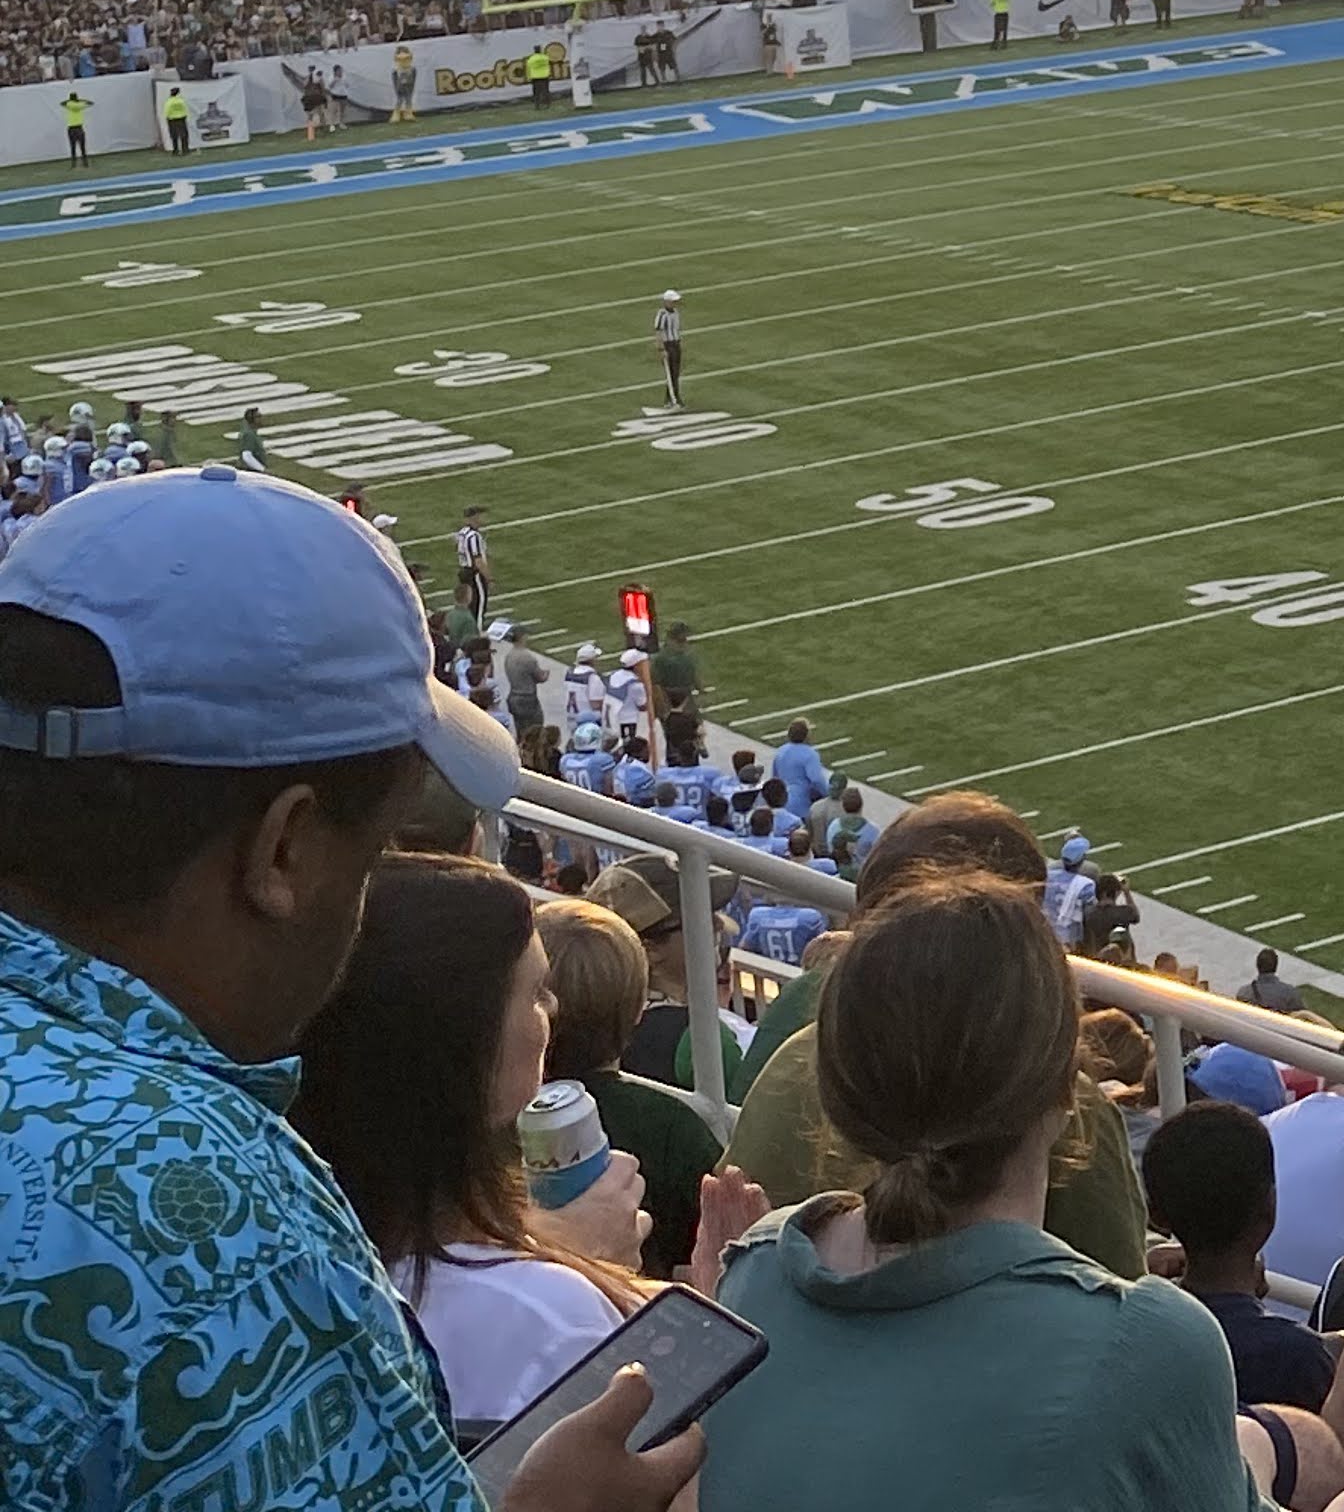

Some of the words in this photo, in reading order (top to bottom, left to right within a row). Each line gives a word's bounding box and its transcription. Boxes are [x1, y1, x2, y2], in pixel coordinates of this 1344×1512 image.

[213, 301, 362, 333] 20
[394, 351, 550, 387] 30
[30, 345, 350, 425] BENSON
[223, 410, 514, 479] FIELD
[611, 412, 778, 450] 40
[855, 478, 1055, 529] 50
[766, 929, 799, 963] 61
